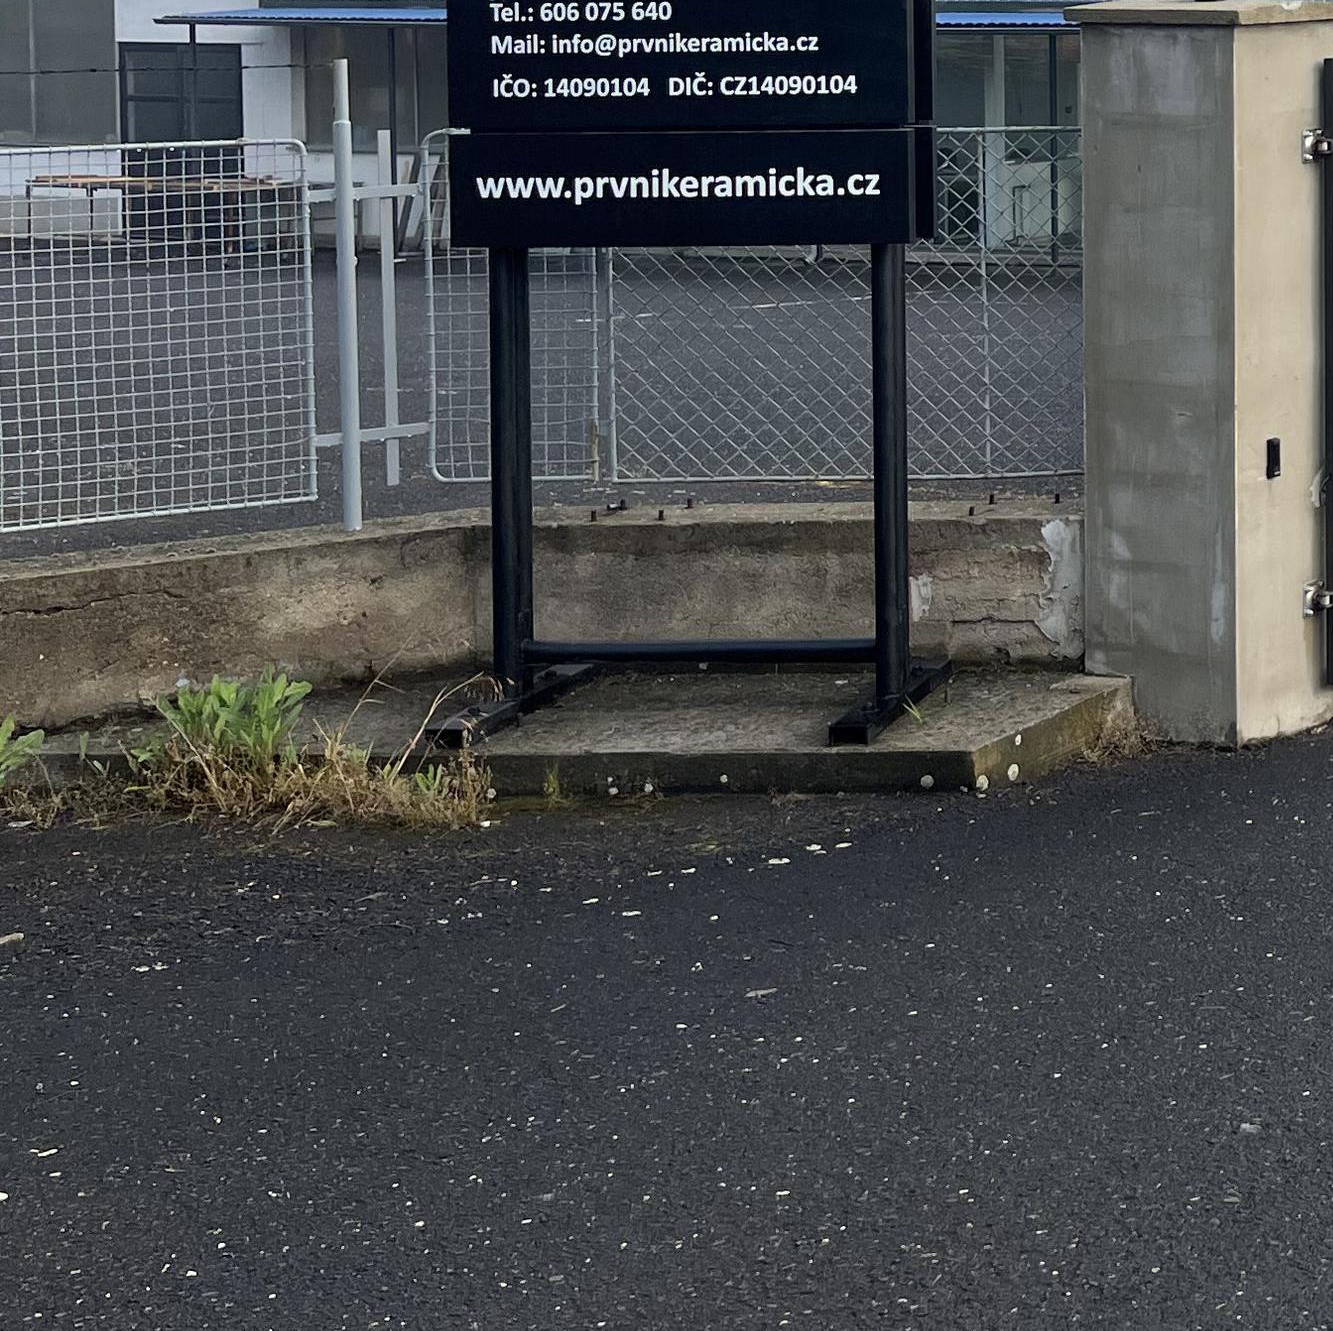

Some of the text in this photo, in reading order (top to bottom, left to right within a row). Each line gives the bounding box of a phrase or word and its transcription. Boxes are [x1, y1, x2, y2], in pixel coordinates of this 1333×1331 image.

[489, 1, 673, 23] Tel.: 606 075 640
[491, 31, 819, 58] Mail: info@prvnikeramicka.cz
[493, 71, 858, 98] IČO: 14090104 DIČ: CZ14090104
[476, 166, 881, 206] www.prvnikeramicka.cz
